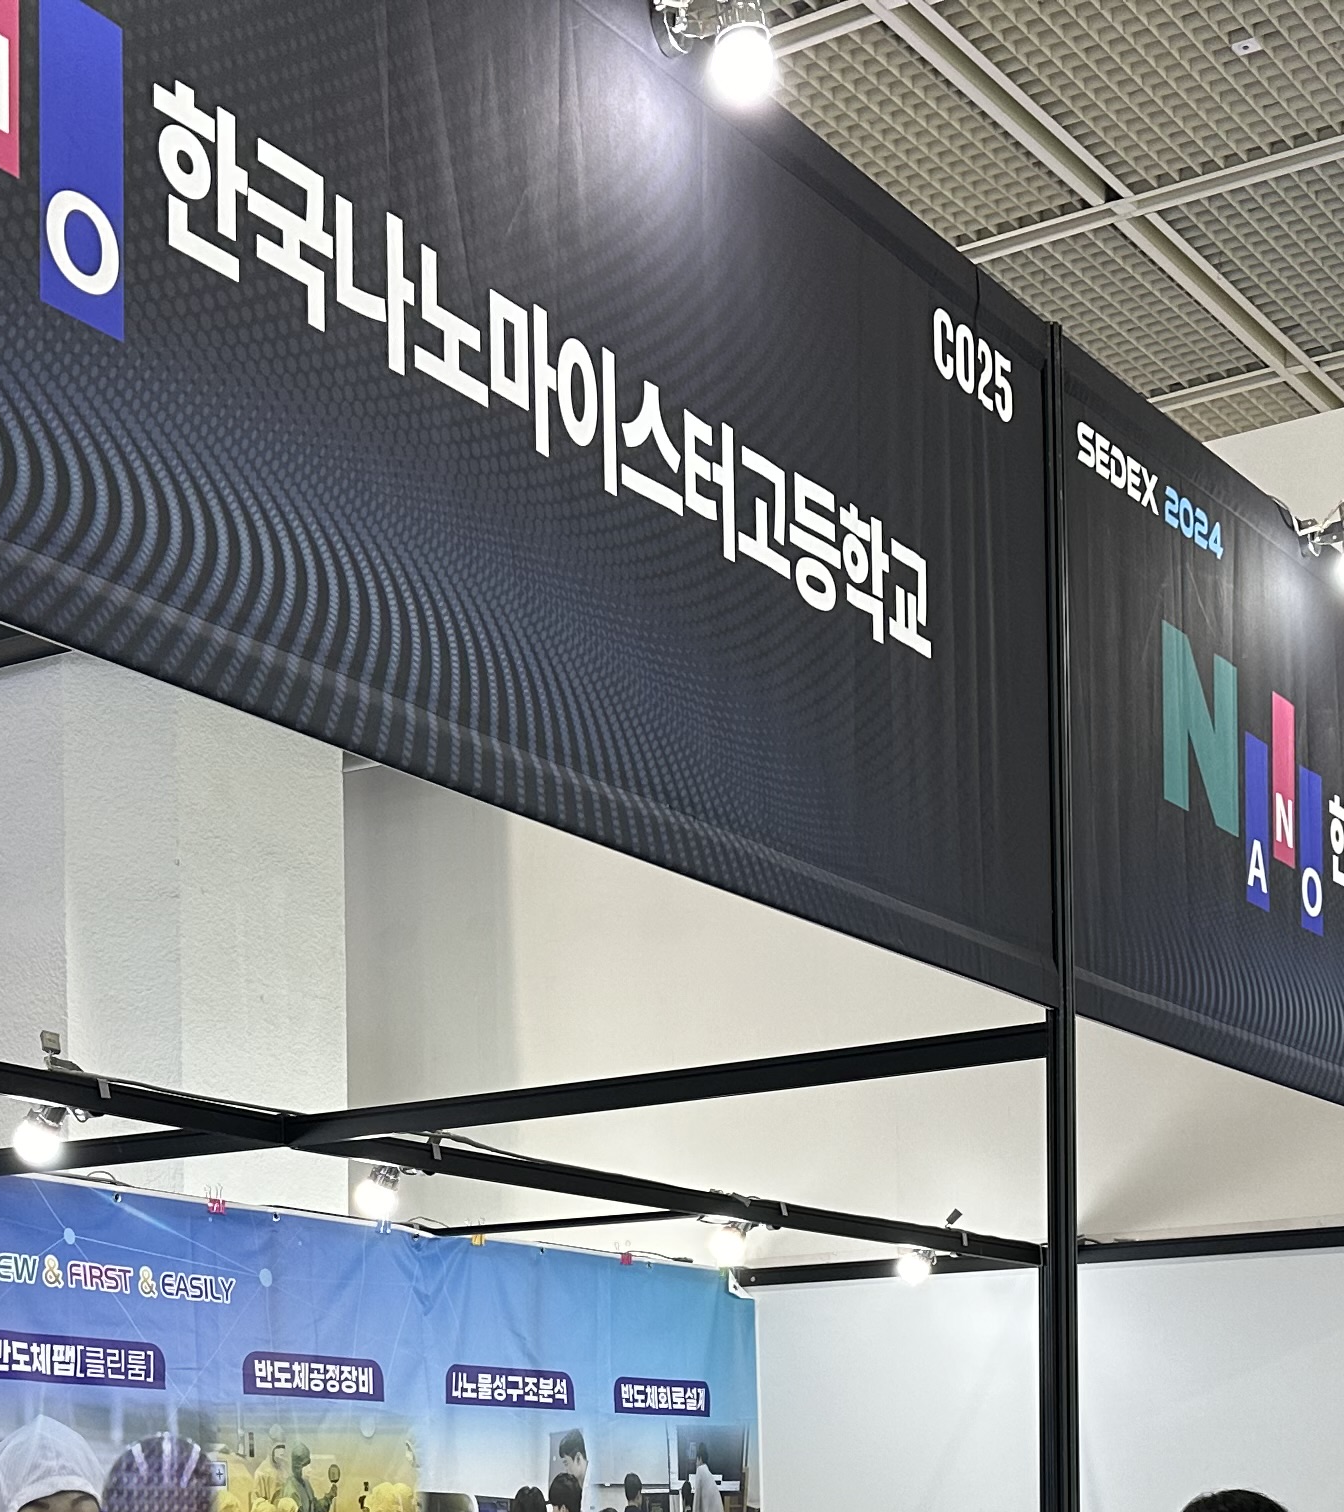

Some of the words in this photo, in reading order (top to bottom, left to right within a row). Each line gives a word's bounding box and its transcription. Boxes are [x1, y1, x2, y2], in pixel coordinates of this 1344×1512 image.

[154, 79, 932, 658] 한국나노마이스터고등학교
[1077, 421, 1159, 516] SEDEX
[1164, 486, 1224, 560] 2024
[43, 1254, 63, 1287] &
[67, 1261, 133, 1294] FIRST
[138, 1265, 158, 1298] &
[160, 1270, 236, 1303] EASILY
[254, 1358, 374, 1395] 반도체공정장비
[451, 1371, 568, 1405] 나노물성구조분석
[621, 1382, 706, 1412] 반도체회로설계
